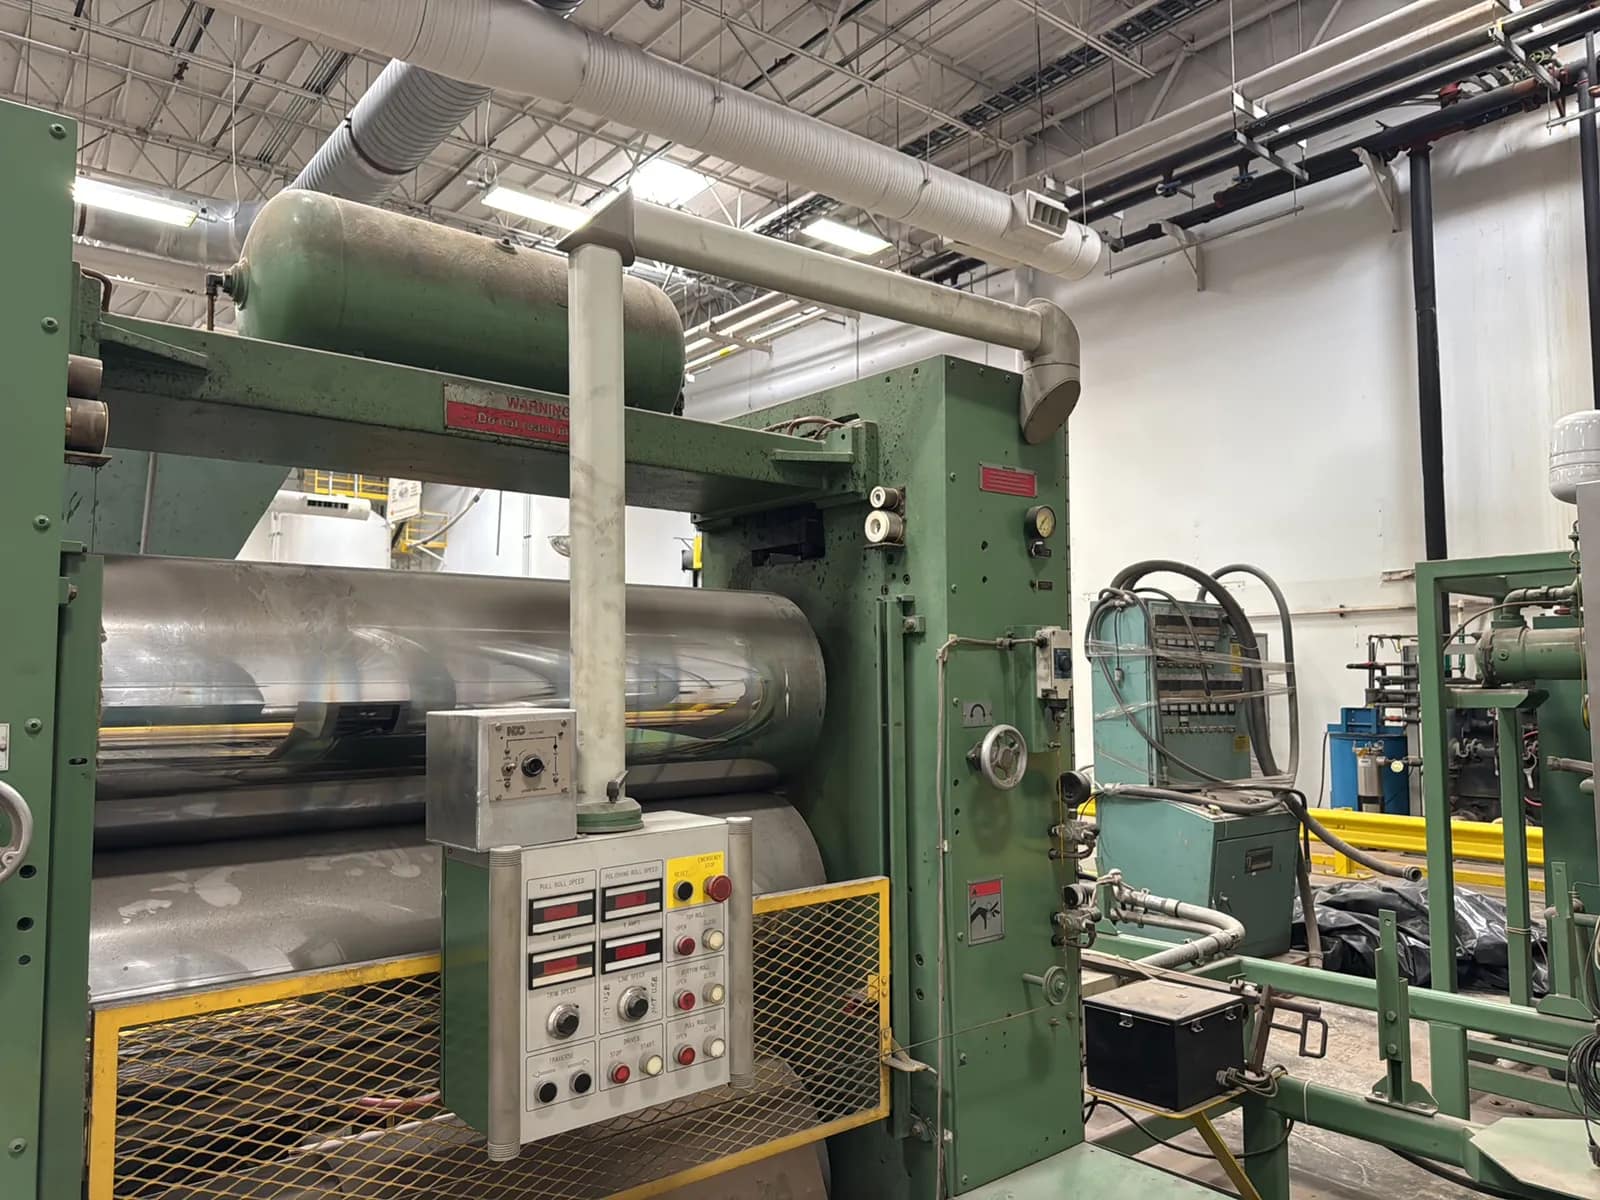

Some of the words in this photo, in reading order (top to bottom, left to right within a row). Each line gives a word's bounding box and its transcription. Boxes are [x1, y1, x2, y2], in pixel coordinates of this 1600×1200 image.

[478, 411, 496, 424] Do
[698, 853, 722, 864] EMERGENCY
[605, 870, 629, 880] POLISHING
[630, 868, 642, 877] ROLL
[643, 865, 659, 875] SPEED
[539, 882, 552, 890] PULL
[554, 879, 567, 888] ROLL
[568, 877, 585, 886] SPEED
[630, 972, 645, 981] SPEED
[560, 986, 576, 996] SPEED
